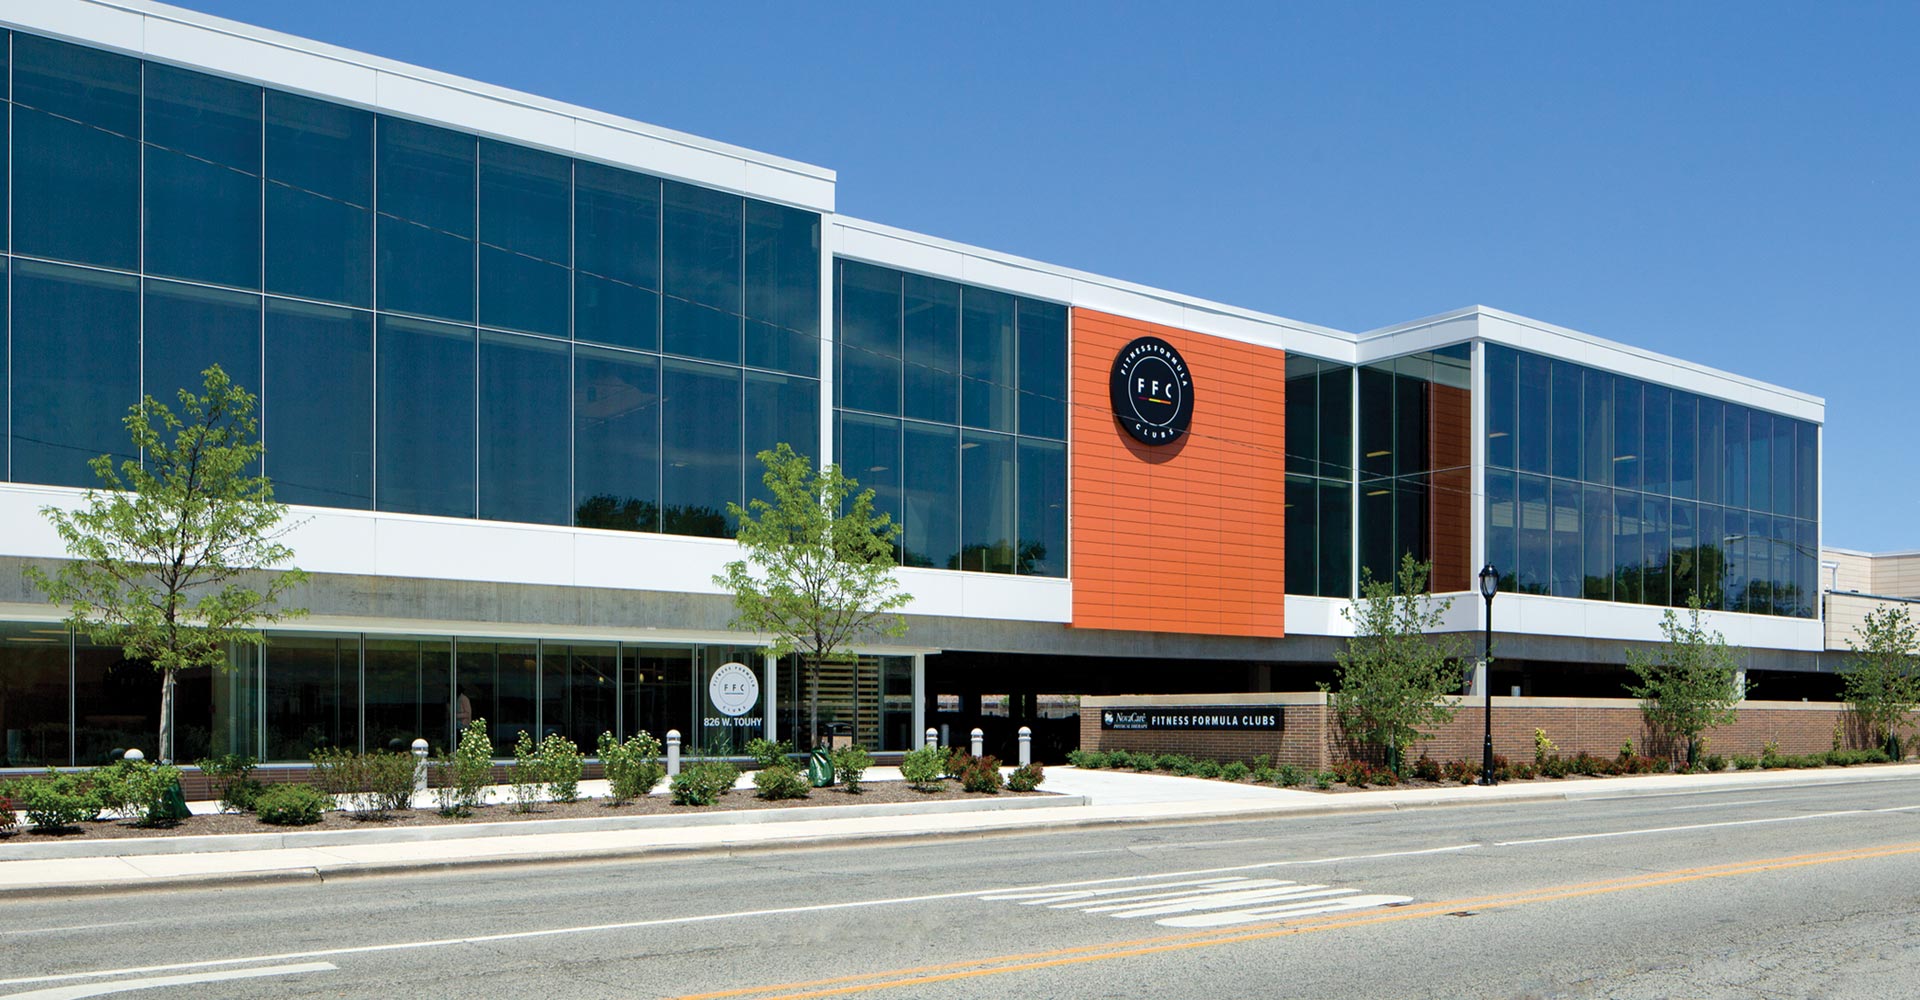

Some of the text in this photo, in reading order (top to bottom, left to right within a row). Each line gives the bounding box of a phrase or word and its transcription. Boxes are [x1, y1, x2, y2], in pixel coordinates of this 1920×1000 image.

[1120, 344, 1188, 387] FITNESS FORMULA
[1135, 423, 1174, 439] CLUBS
[703, 717, 762, 727] 826 W. TOUHY
[1151, 715, 1276, 726] FITNESS FORMULA CLUBS
